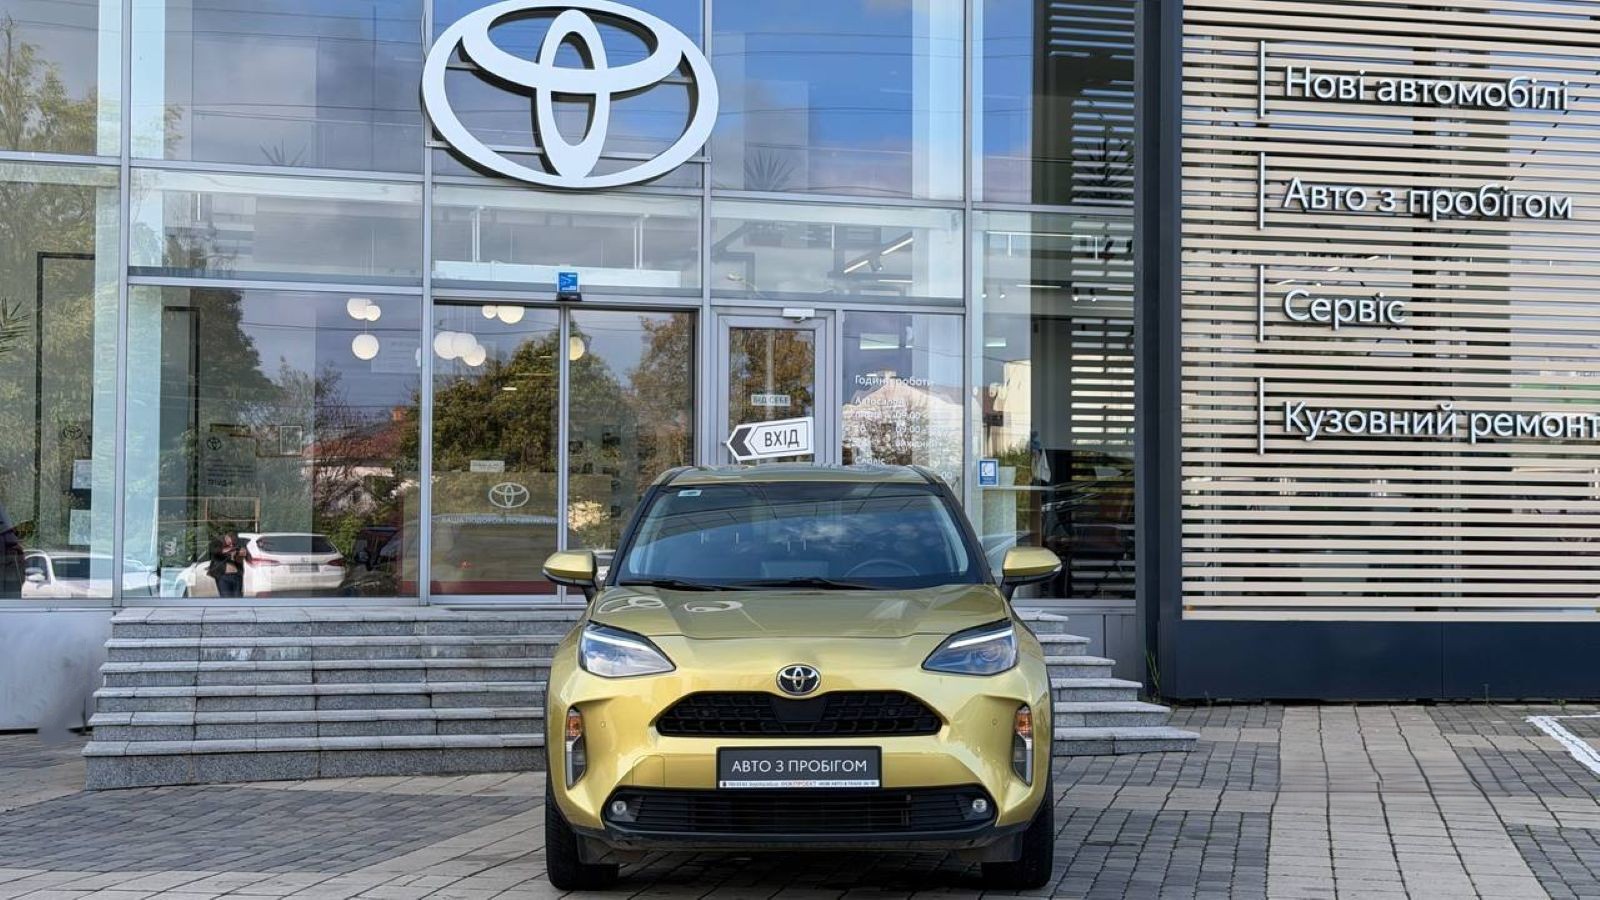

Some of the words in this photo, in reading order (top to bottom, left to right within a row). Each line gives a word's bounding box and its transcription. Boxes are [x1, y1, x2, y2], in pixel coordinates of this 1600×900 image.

[1284, 65, 1366, 101] Нові
[1377, 76, 1570, 110] автомобілі
[1282, 177, 1368, 213] Авто
[1377, 185, 1396, 212] з
[1408, 183, 1574, 222] пробігом
[1283, 289, 1406, 331] Сервіс
[763, 428, 801, 448] ВХІД
[1284, 401, 1458, 442] Кузовний
[1469, 412, 1600, 445] ремонт
[731, 760, 771, 772] АВТО
[775, 760, 784, 772] З
[788, 760, 867, 773] ПРОБІГОМ
